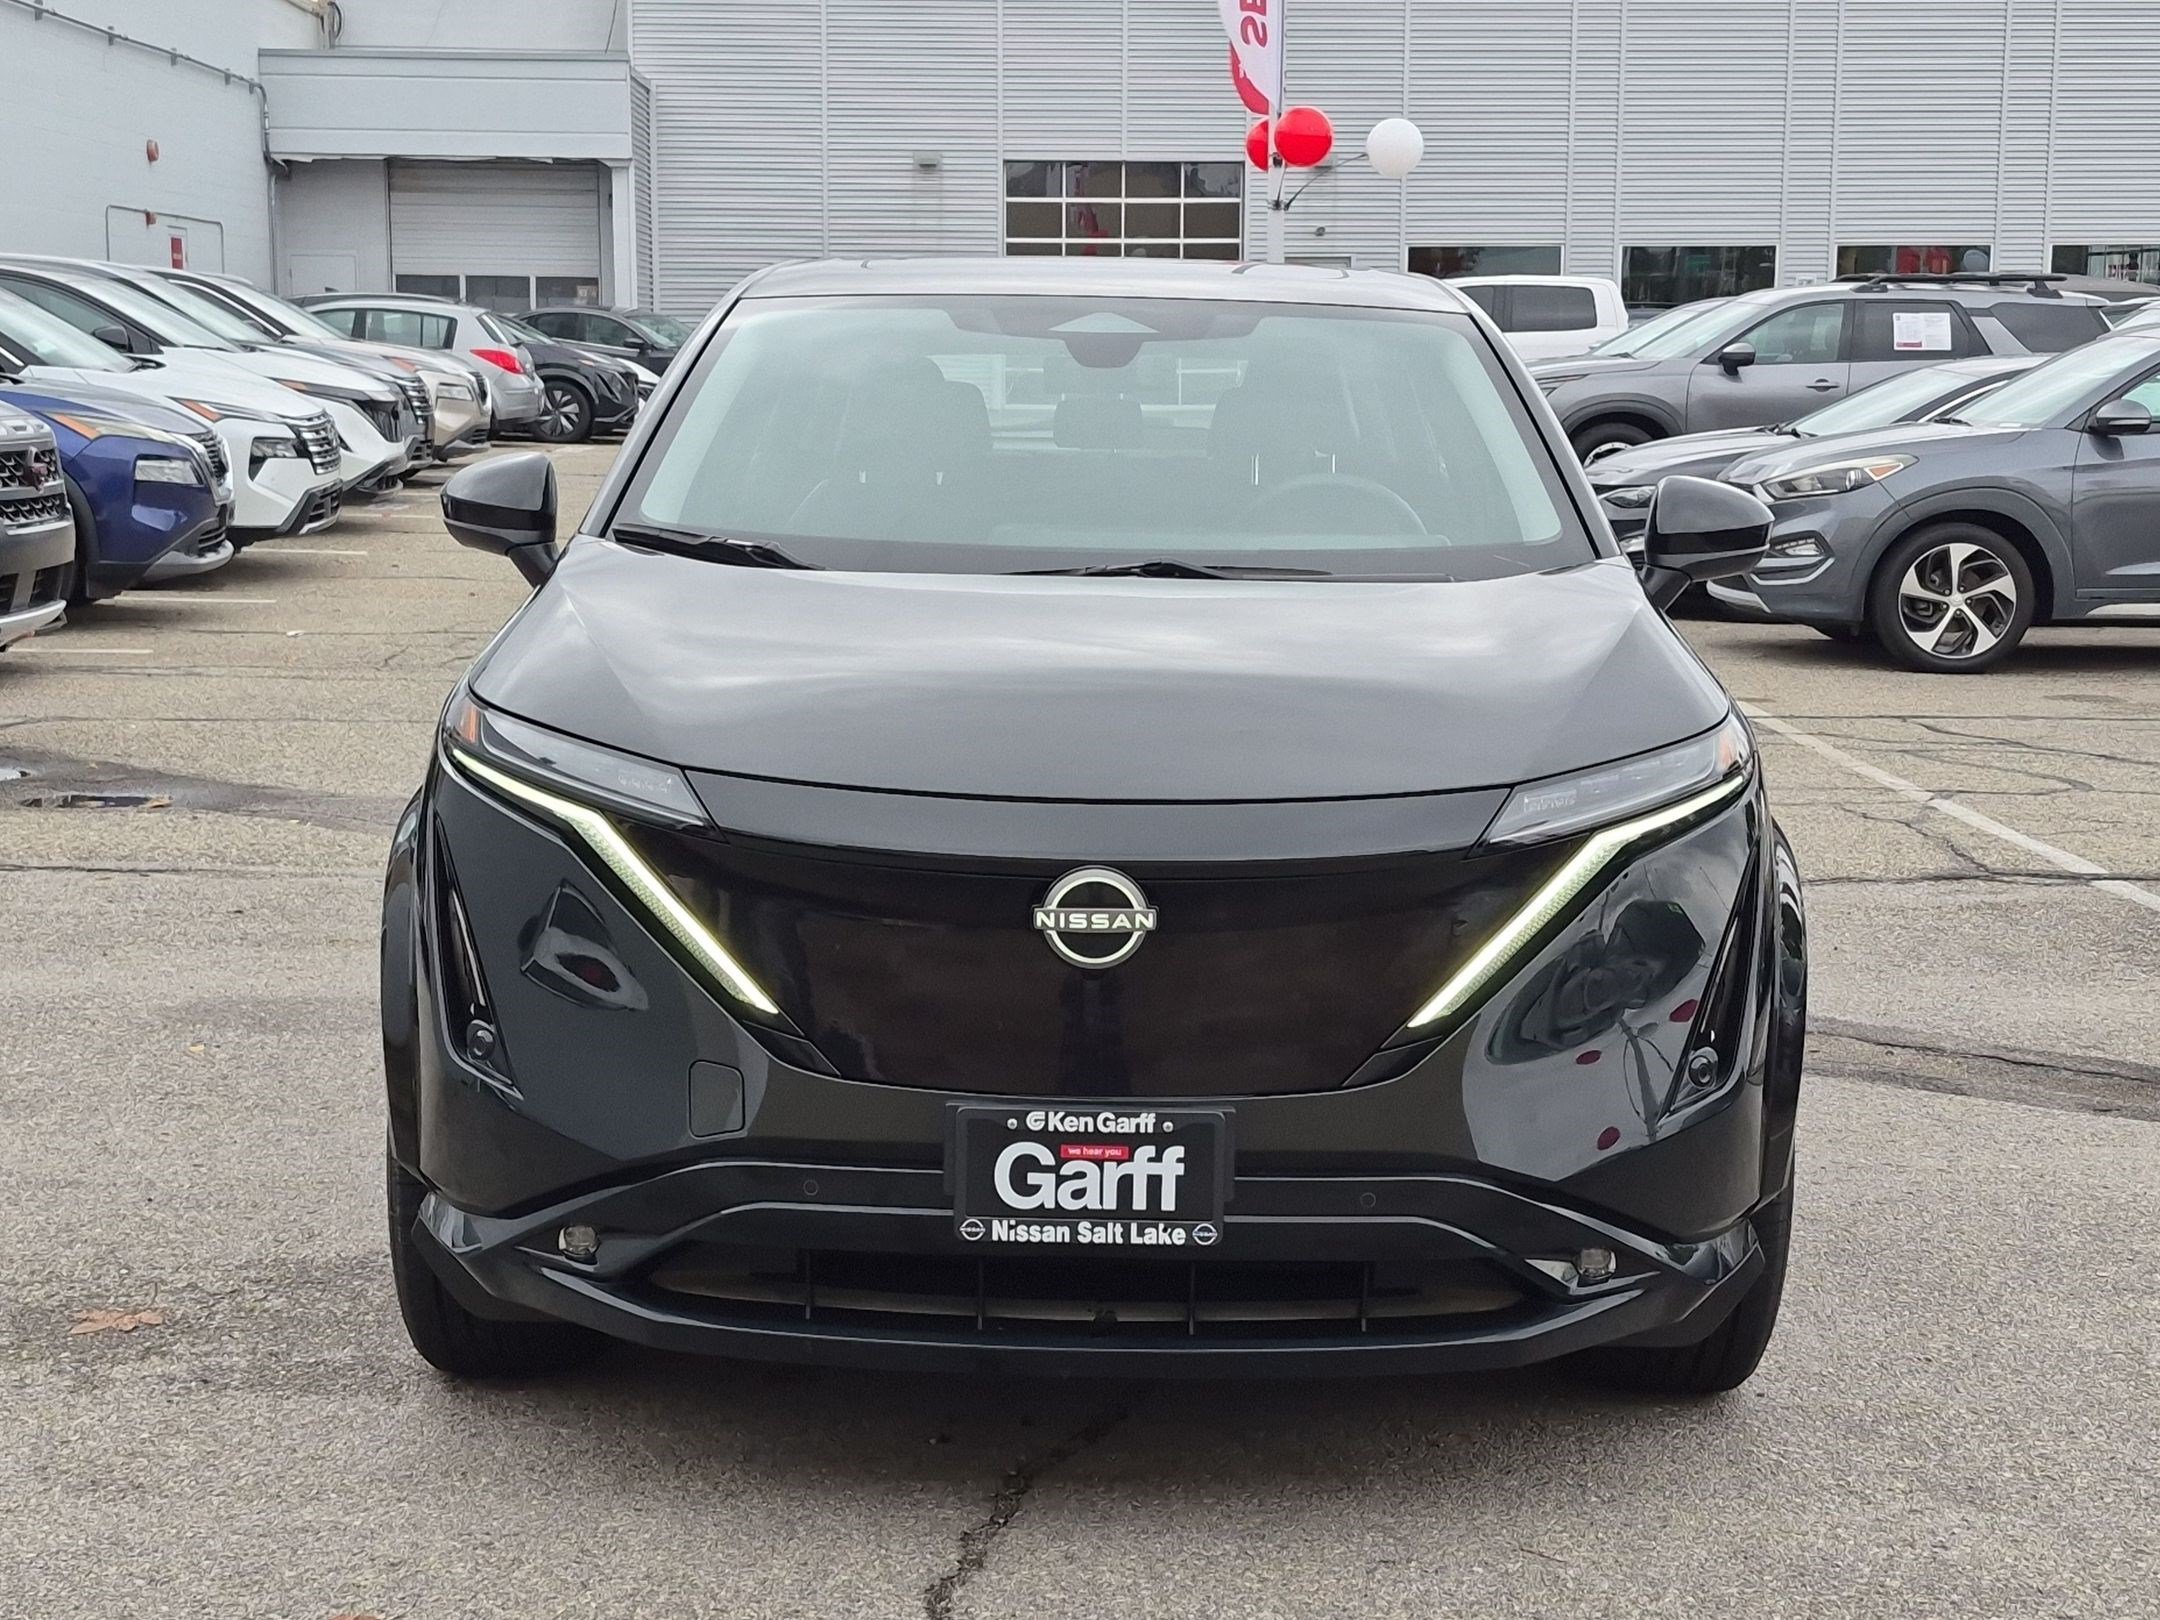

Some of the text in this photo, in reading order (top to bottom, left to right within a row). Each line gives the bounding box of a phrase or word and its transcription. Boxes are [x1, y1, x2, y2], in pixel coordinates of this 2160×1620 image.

[1036, 911, 1154, 929] NISSAN
[1047, 1111, 1156, 1134] Ken Garff
[1068, 1146, 1122, 1158] we hear you
[994, 1141, 1185, 1211] Garff
[991, 1219, 1186, 1246] Nissan Salt Lake
